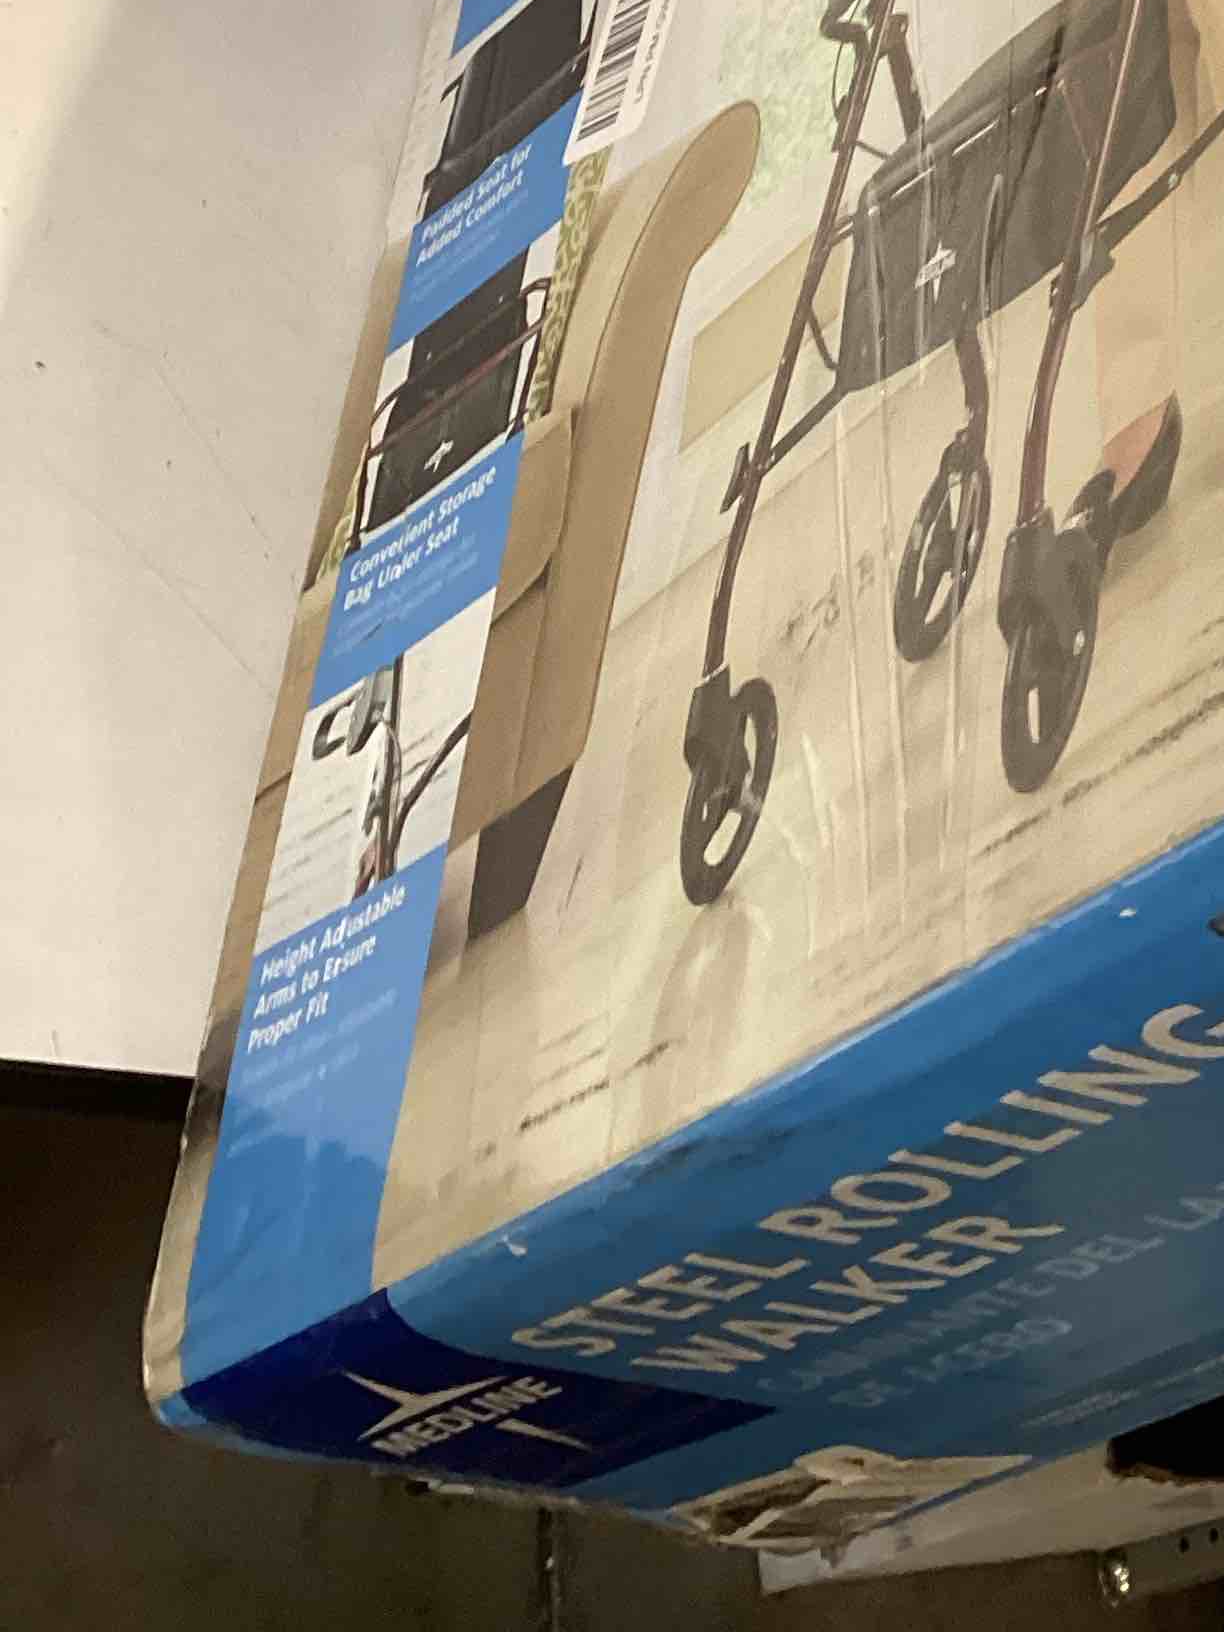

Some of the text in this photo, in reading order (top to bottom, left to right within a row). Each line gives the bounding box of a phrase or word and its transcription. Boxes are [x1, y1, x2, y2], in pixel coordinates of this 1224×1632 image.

[414, 168, 524, 269] Added Comfort
[420, 142, 533, 245] Padded Seat for
[342, 514, 461, 613] Bag Under Seat
[349, 465, 498, 583] Convenient Storage
[259, 882, 407, 988] Height Adjustable
[246, 989, 331, 1055] Proper Fit
[253, 980, 298, 1020] Arms
[300, 967, 321, 995] to
[509, 1250, 813, 1359] STEEL
[629, 1214, 1067, 1375] WALKER
[370, 1374, 564, 1459] MEDLINE
